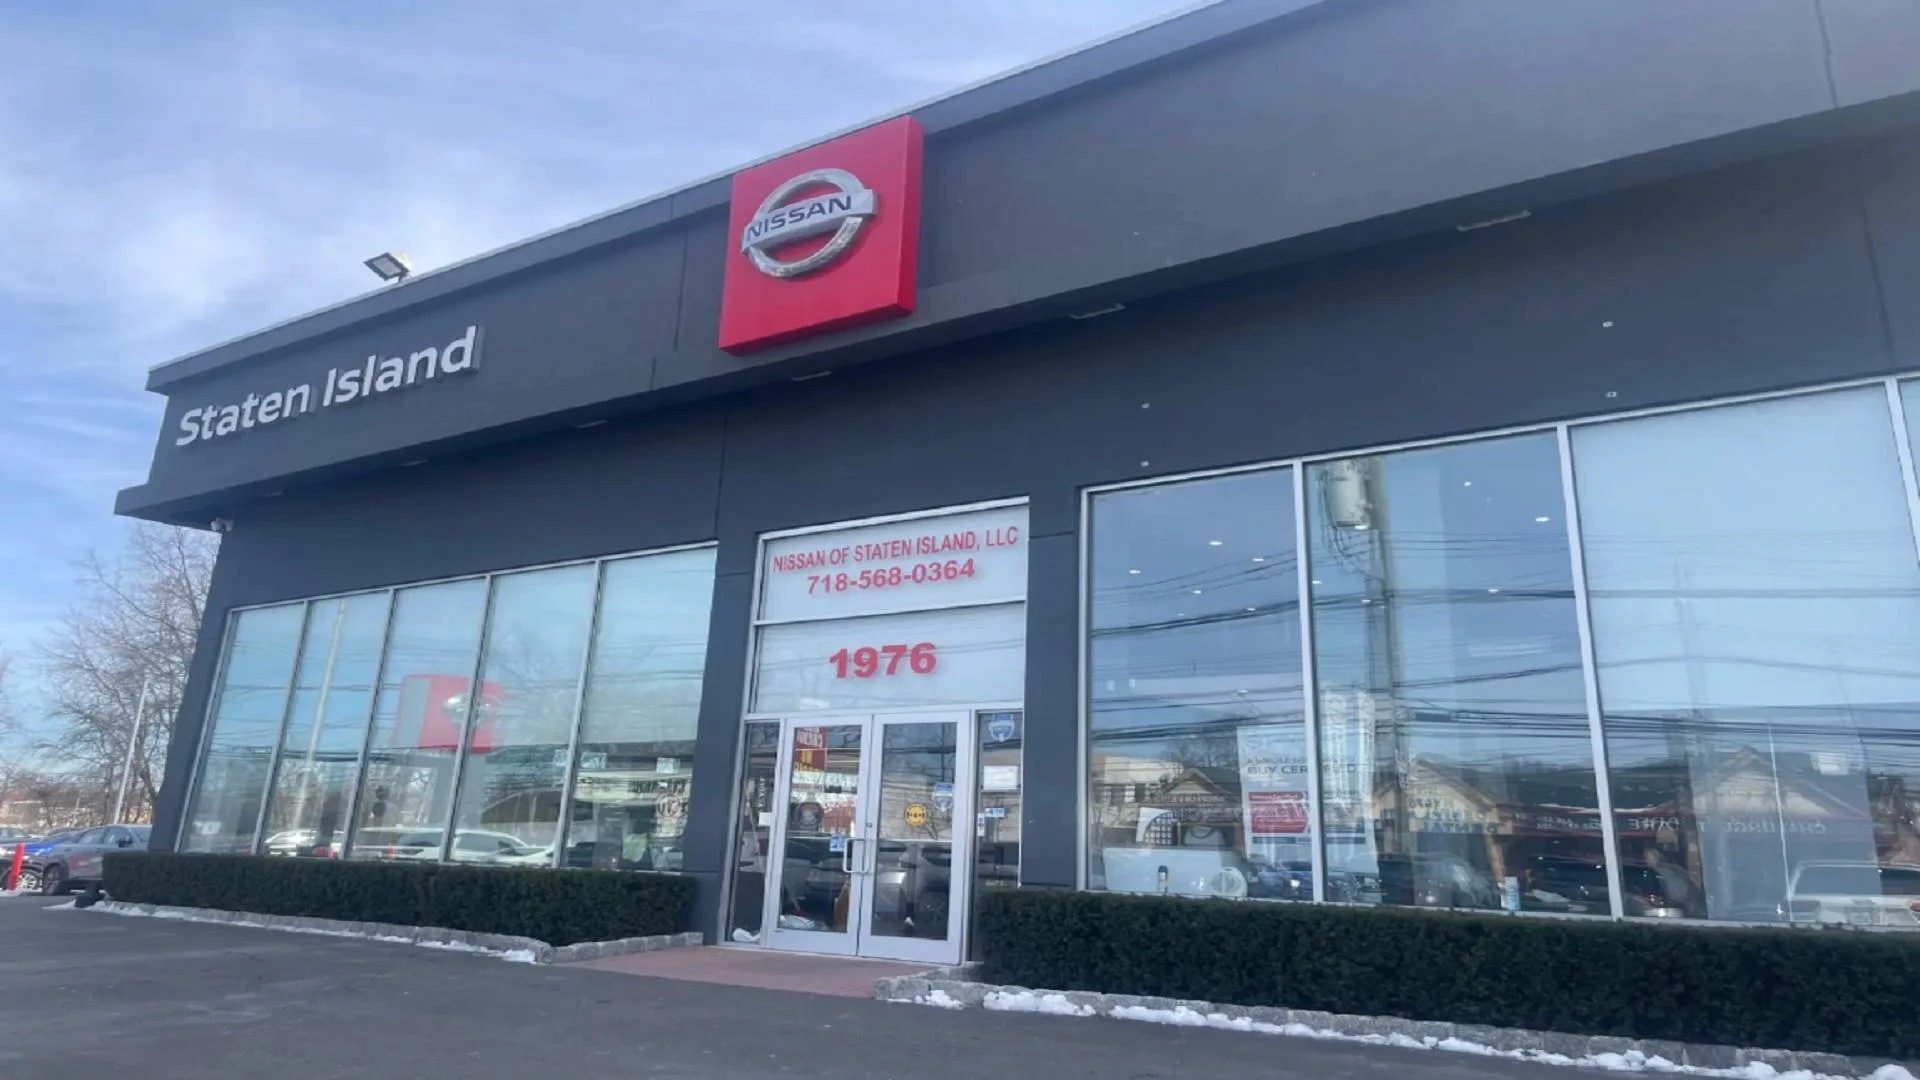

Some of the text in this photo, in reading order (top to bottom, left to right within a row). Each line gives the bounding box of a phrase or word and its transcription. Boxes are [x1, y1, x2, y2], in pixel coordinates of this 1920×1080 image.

[748, 195, 851, 238] NISSAN
[175, 325, 477, 446] Staten Island
[773, 526, 1018, 572] NISSAN OF STATEN ISLAND, LLC
[807, 560, 975, 594] 718-568-0364
[829, 642, 936, 678] 1976
[1248, 766, 1277, 775] BUY
